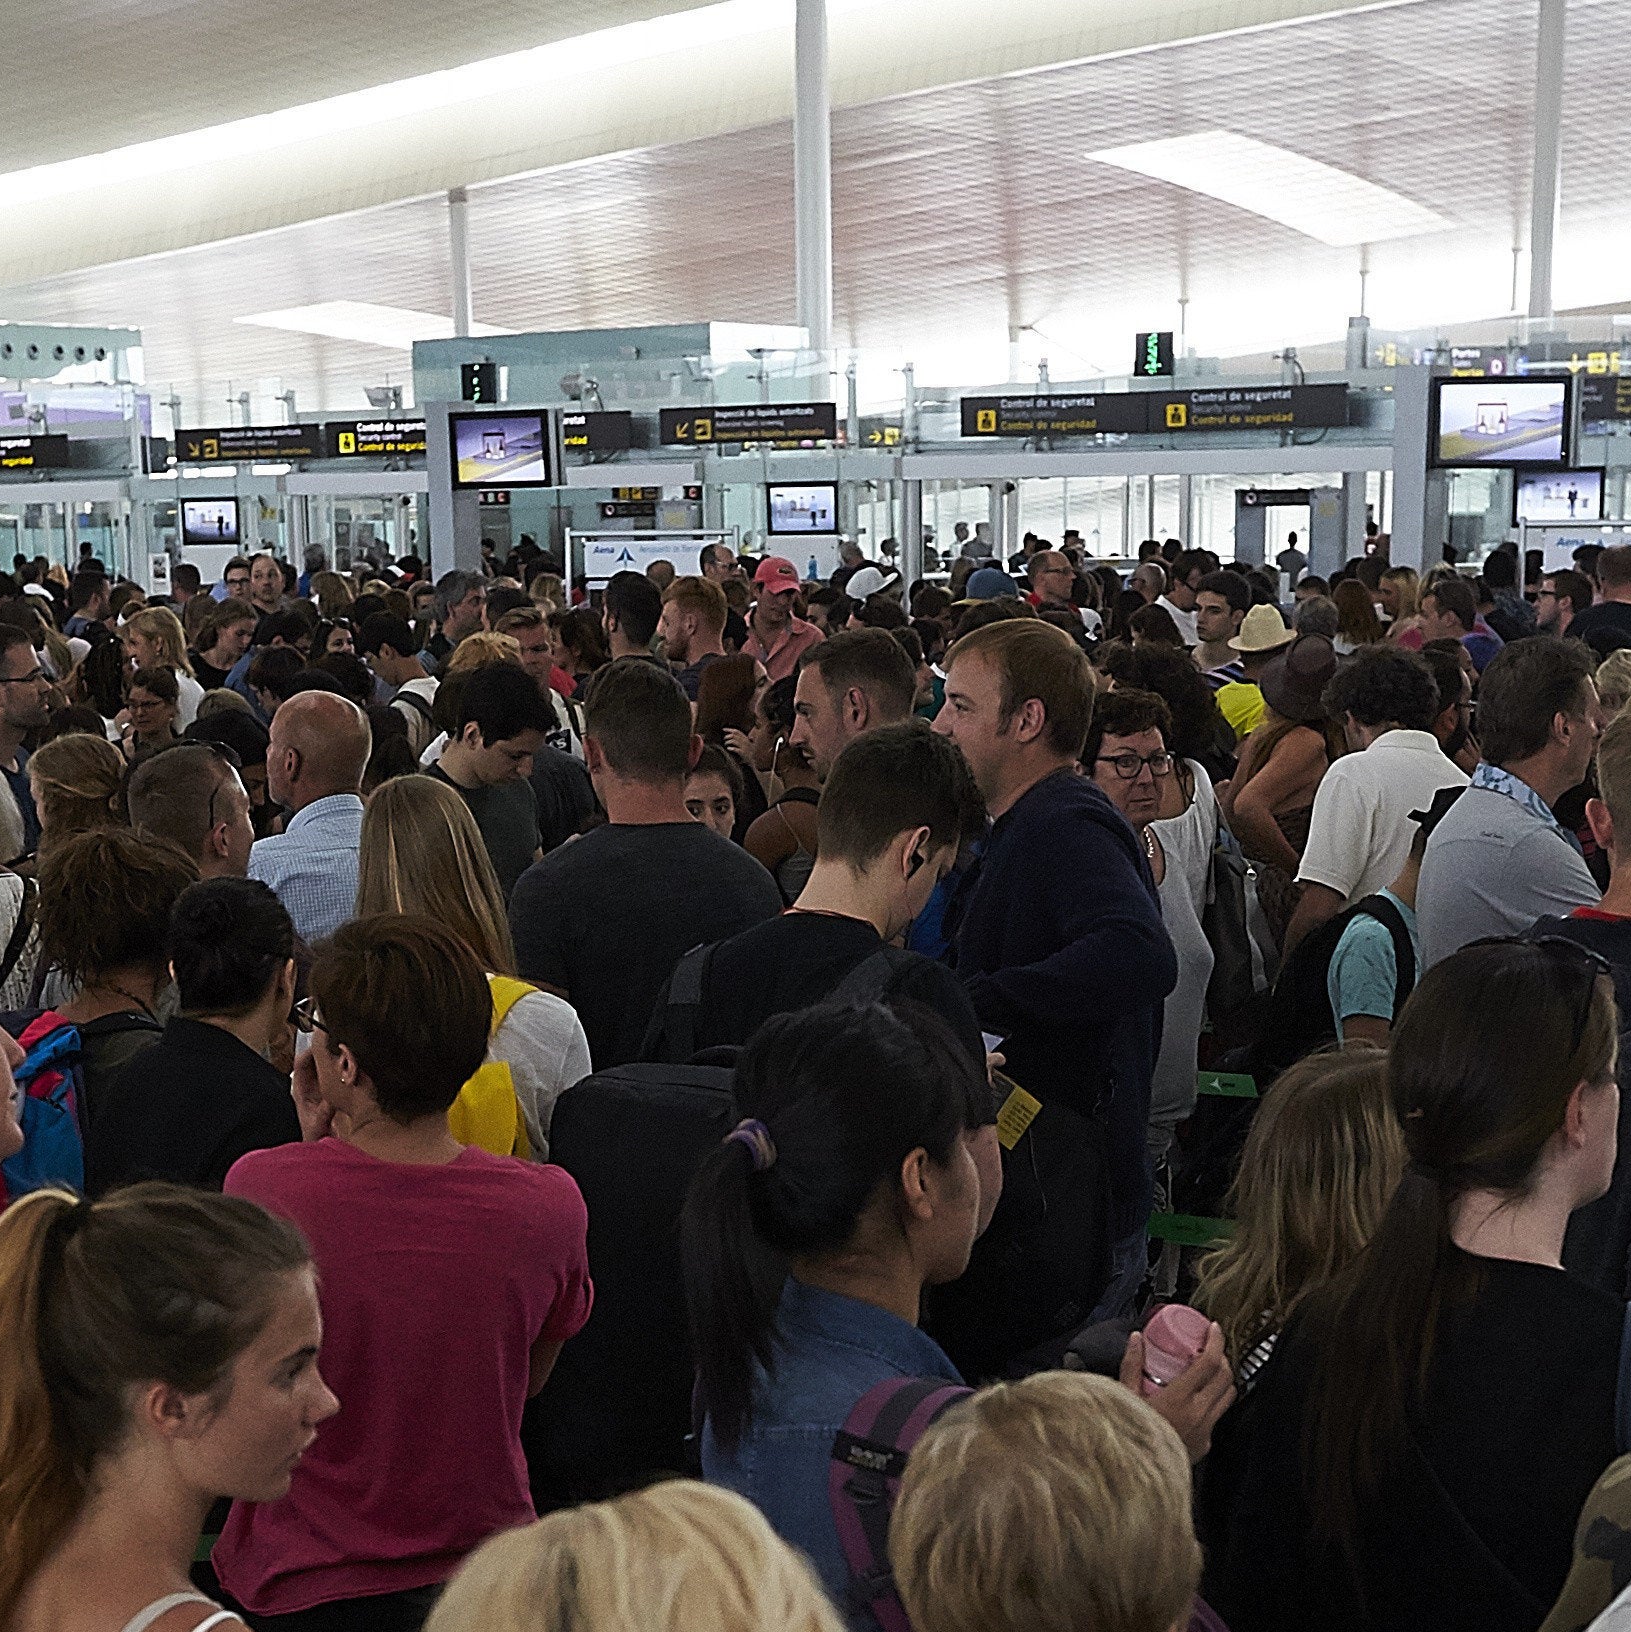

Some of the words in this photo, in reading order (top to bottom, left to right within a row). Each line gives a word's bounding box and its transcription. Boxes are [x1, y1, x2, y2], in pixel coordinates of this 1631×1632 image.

[1190, 391, 1227, 403] Control
[1229, 391, 1242, 401] de
[1245, 389, 1292, 402] seguretat
[1000, 398, 1034, 408] Control
[1036, 398, 1048, 408] de
[1050, 397, 1095, 408] seguretat
[1191, 415, 1227, 425] Control
[1229, 414, 1241, 424] de
[1244, 412, 1294, 425] seguridad
[357, 422, 384, 432] Control
[385, 421, 394, 432] de
[1000, 420, 1034, 431] Control
[1036, 420, 1048, 430] de
[1050, 419, 1097, 431] seguridad
[358, 443, 384, 452] Control
[386, 442, 395, 451] de
